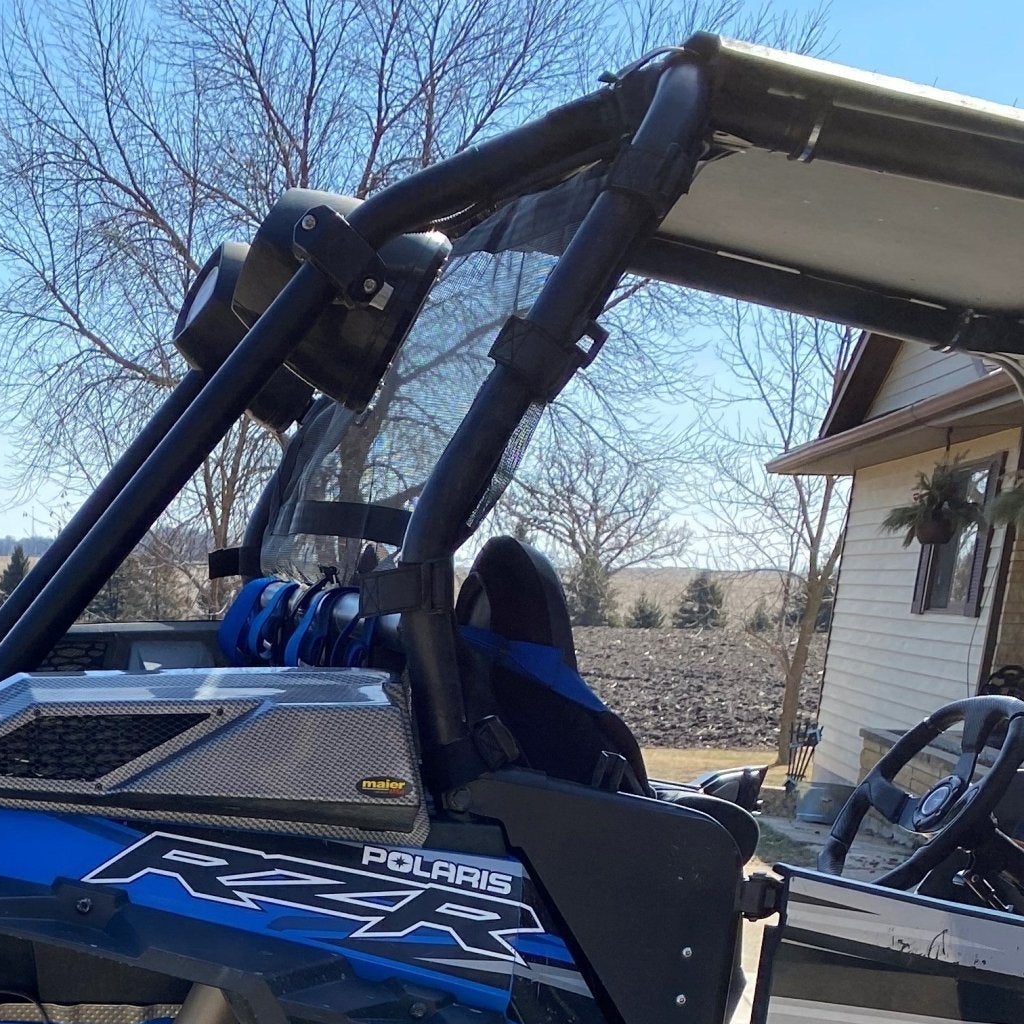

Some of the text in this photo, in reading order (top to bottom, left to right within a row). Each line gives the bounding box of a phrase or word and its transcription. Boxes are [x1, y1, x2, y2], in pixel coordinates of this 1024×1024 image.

[361, 779, 406, 789] maier
[361, 845, 513, 895] POLARIS
[81, 831, 545, 968] RZR
